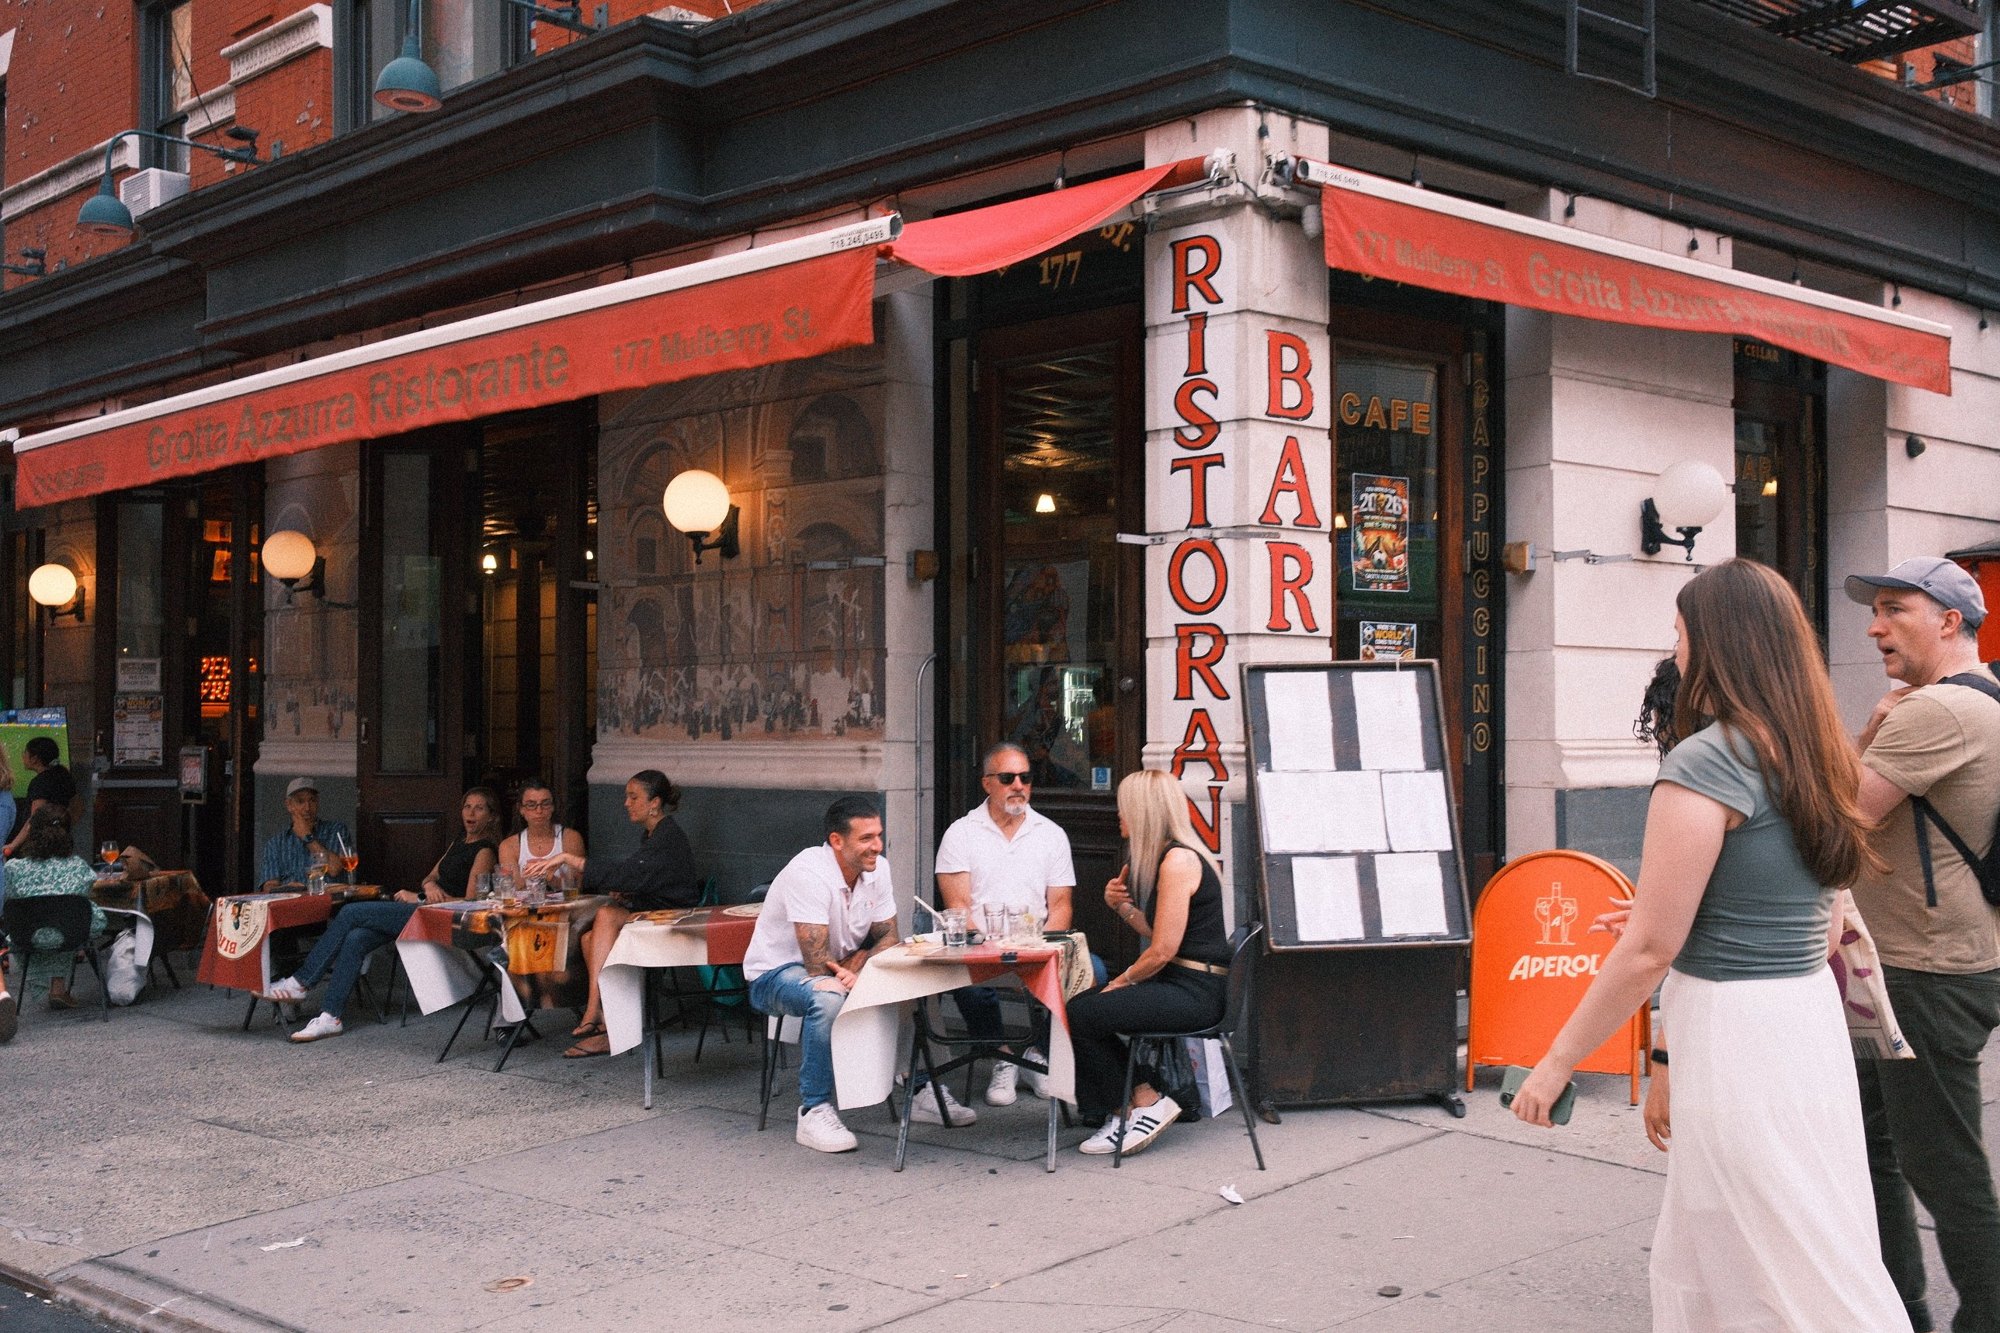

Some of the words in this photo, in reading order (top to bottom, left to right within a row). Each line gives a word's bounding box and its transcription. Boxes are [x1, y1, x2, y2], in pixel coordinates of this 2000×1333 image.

[1039, 251, 1083, 290] 177
[1355, 229, 1388, 261] 177
[1394, 238, 1479, 288] Mulberry
[1527, 252, 1624, 311] Grotta
[1627, 275, 1742, 323] Azzurra
[148, 415, 229, 471] Grotta
[234, 392, 356, 450] Azzurra
[368, 340, 570, 425] Ristorante
[613, 338, 655, 375] 177
[659, 322, 773, 365] Mulberry
[782, 306, 818, 342] St.
[1340, 391, 1431, 436] CAFE
[1258, 329, 1321, 633] BAR
[1359, 492, 1402, 515] 2026
[1167, 234, 1230, 874] RISTORAN
[1472, 379, 1491, 753] CAPPUCCINO
[1375, 630, 1403, 640] WORLD
[1508, 954, 1600, 980] APEROL
